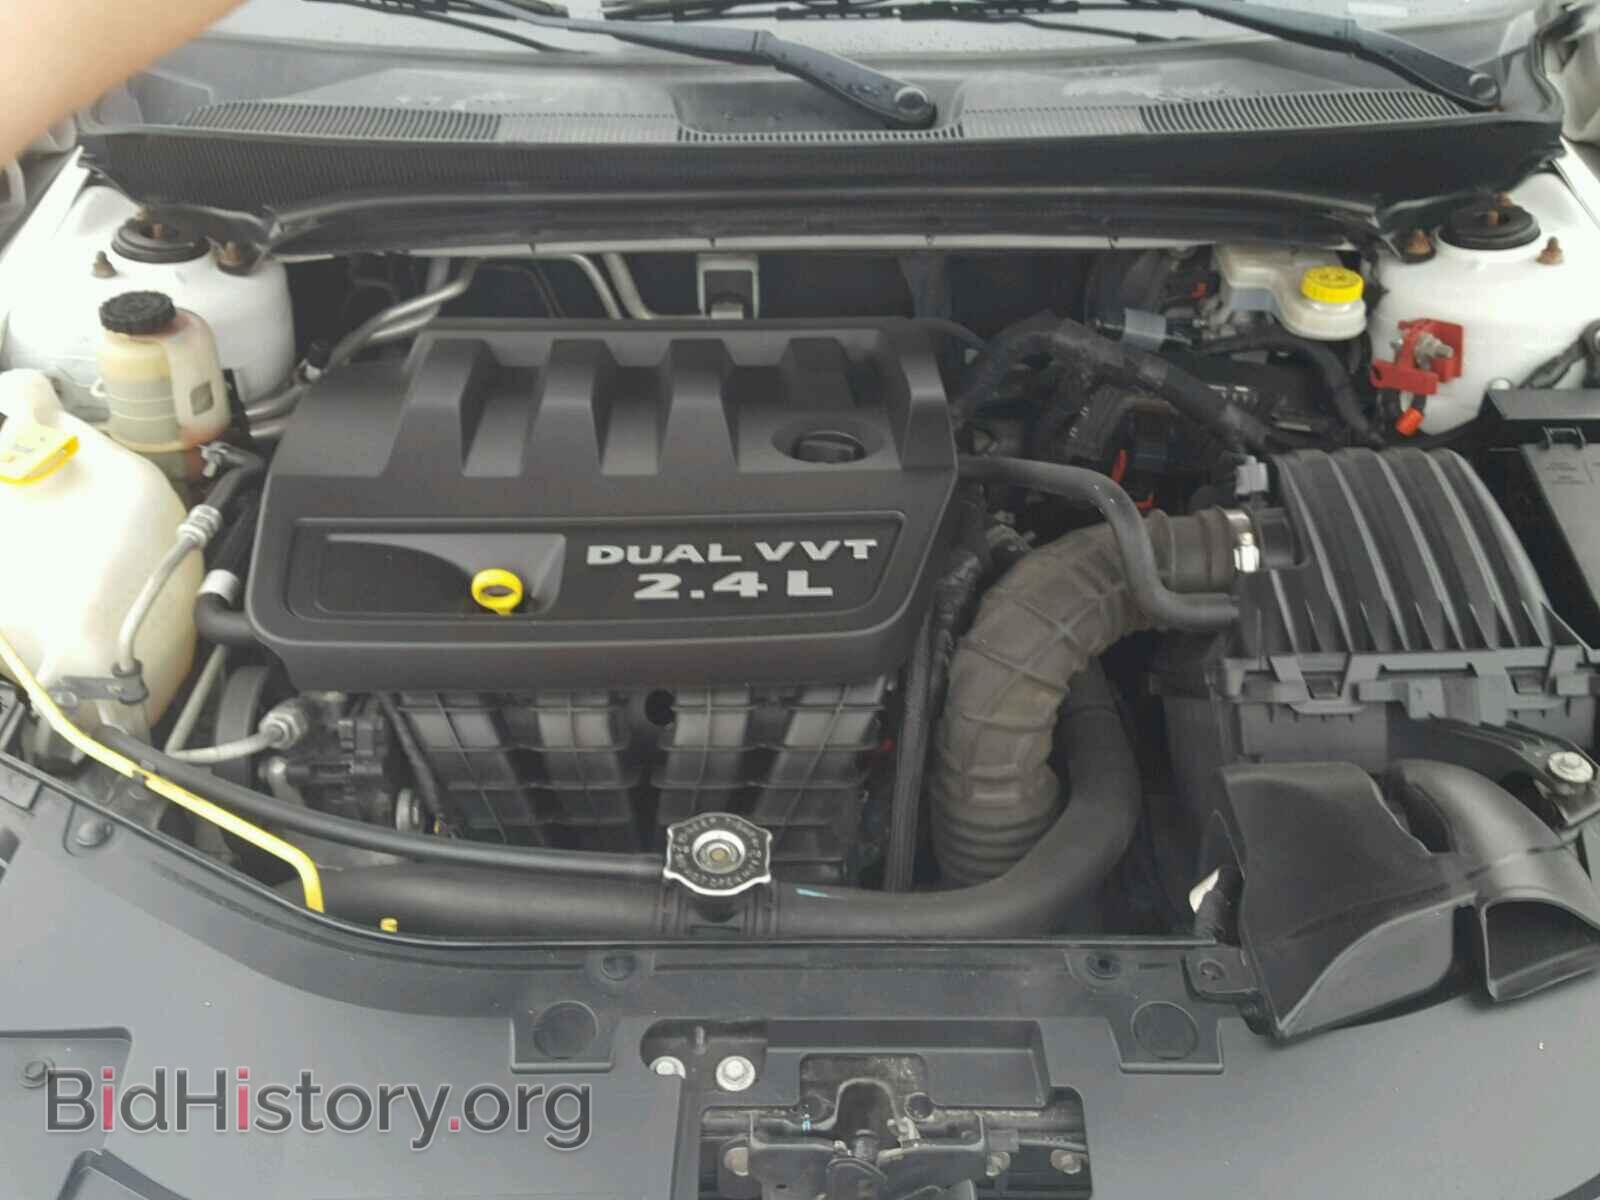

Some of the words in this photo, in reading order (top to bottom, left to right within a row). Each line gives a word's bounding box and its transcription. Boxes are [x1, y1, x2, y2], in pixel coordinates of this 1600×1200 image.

[586, 543, 742, 565] DUAL
[754, 539, 878, 561] VVT
[633, 572, 768, 600] 2.4
[786, 569, 834, 597] L
